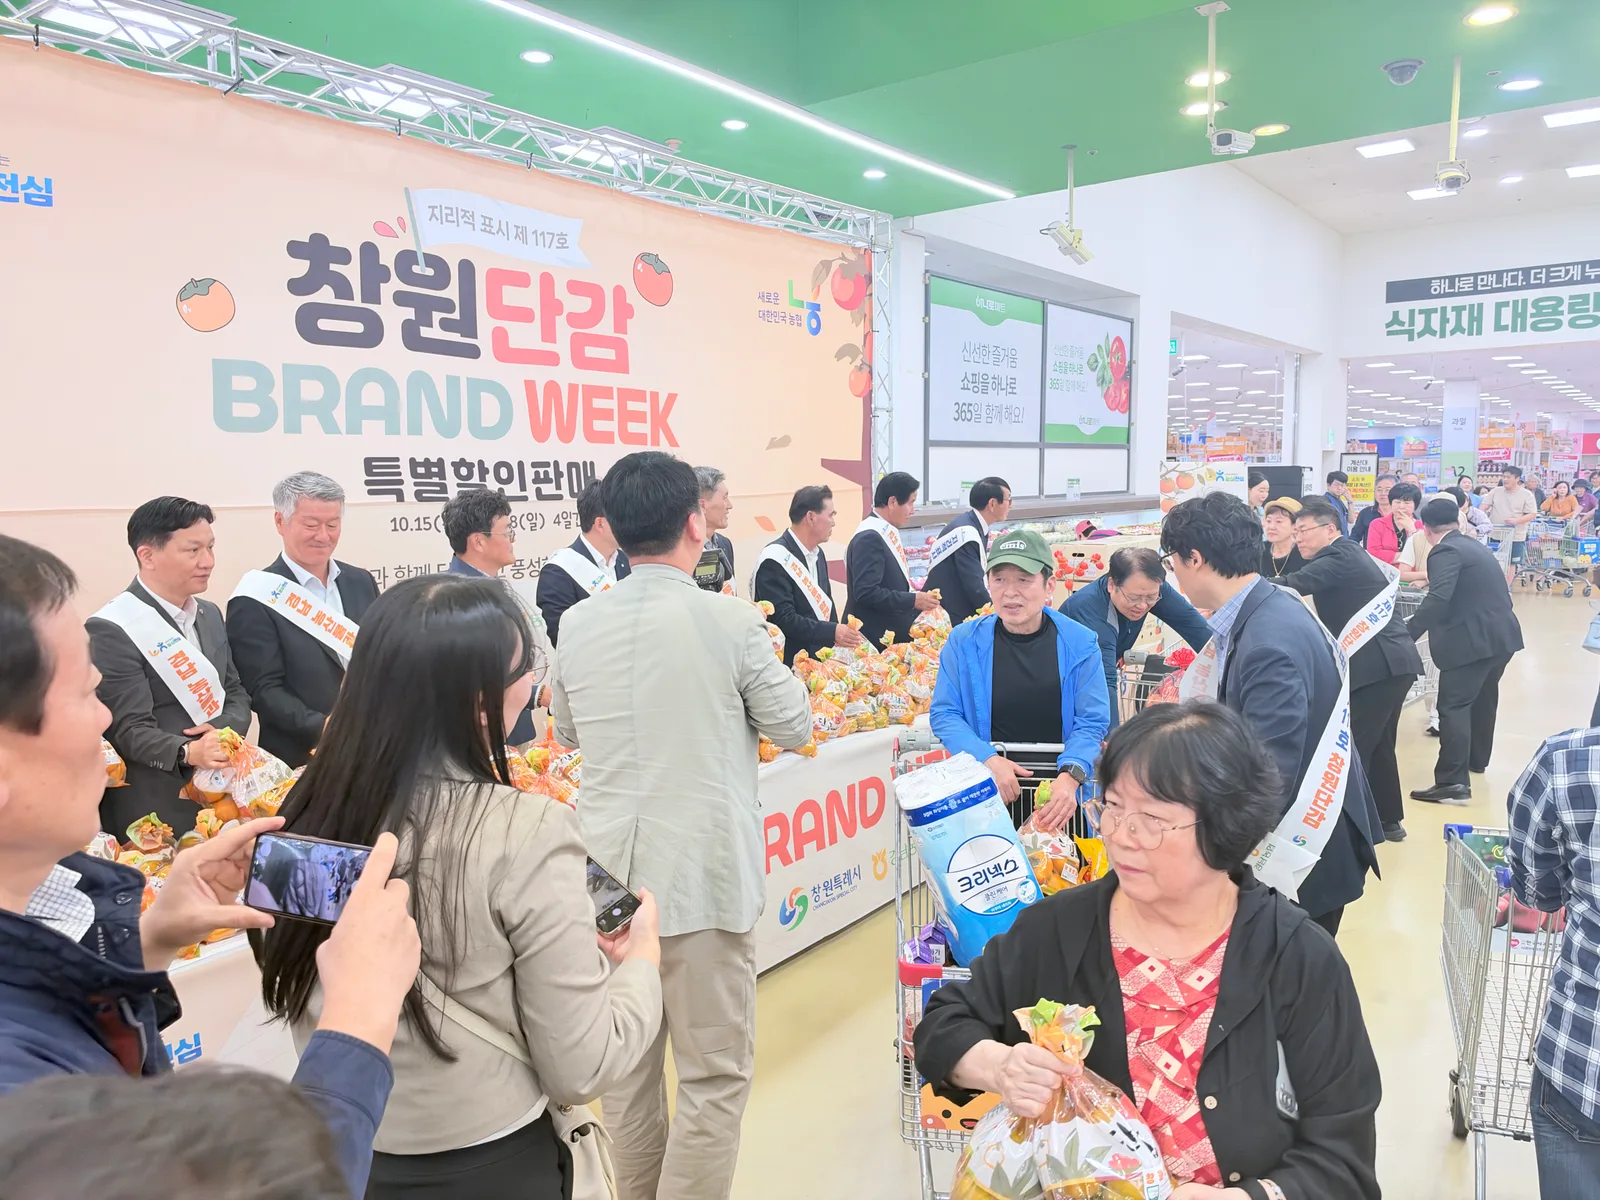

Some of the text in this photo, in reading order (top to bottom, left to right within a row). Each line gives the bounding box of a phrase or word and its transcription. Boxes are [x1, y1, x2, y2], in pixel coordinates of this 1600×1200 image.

[428, 204, 569, 249] 지리적 표시 제 117호
[1430, 275, 1475, 295] 하나로
[1477, 270, 1526, 291] 만나다.
[1530, 268, 1546, 284] 더
[1549, 264, 1582, 284] 크게
[757, 291, 780, 305] 새로운
[975, 295, 1006, 313] 하나로마트
[757, 309, 803, 327] 대한민국 농협
[1384, 302, 1484, 342] 식자재
[962, 341, 1018, 369] 신선한 즐거움
[1053, 360, 1084, 376] 쇼핑을 하나로
[960, 371, 1017, 397] 쇼핑을 하나로
[211, 358, 680, 447] BRAND WEEK
[953, 401, 1025, 425] 365일 함께 해요!
[1452, 416, 1467, 426] 과일
[390, 514, 442, 533] 10.15(
[285, 592, 314, 617] 경남
[167, 649, 199, 681] 경남
[1302, 751, 1345, 830] 창원단감
[764, 775, 886, 876] RAND
[1253, 842, 1276, 872] 경남농협
[810, 863, 862, 903] 창원특례시
[957, 859, 1020, 893] 크리넥스
[165, 1032, 203, 1065] 심
